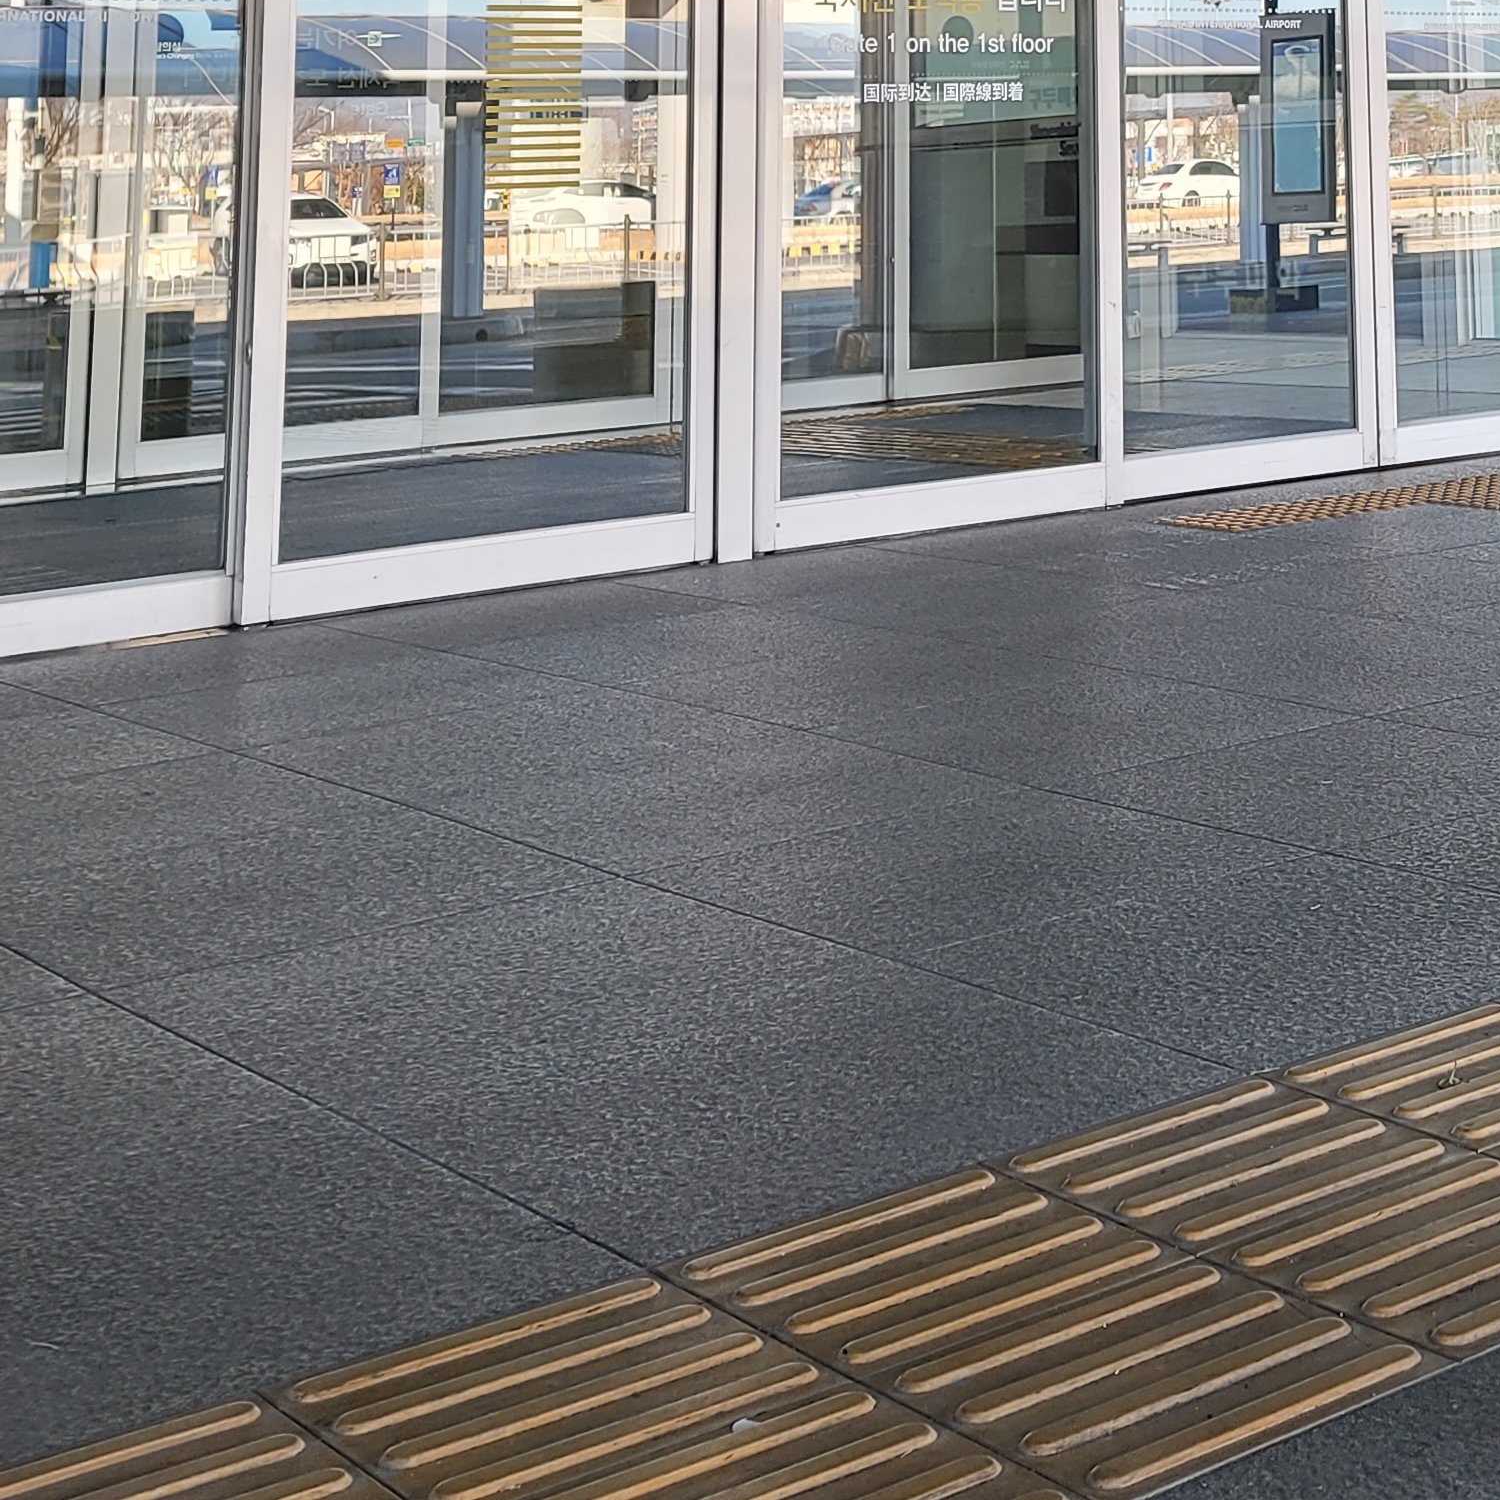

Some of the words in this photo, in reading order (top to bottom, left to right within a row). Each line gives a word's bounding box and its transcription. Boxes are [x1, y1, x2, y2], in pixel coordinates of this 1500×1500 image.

[1263, 19, 1302, 30] AIRPORT
[887, 33, 896, 53] 1
[905, 37, 932, 53] on
[937, 33, 970, 53] the
[977, 33, 1006, 53] 1st
[1011, 32, 1054, 53] floor
